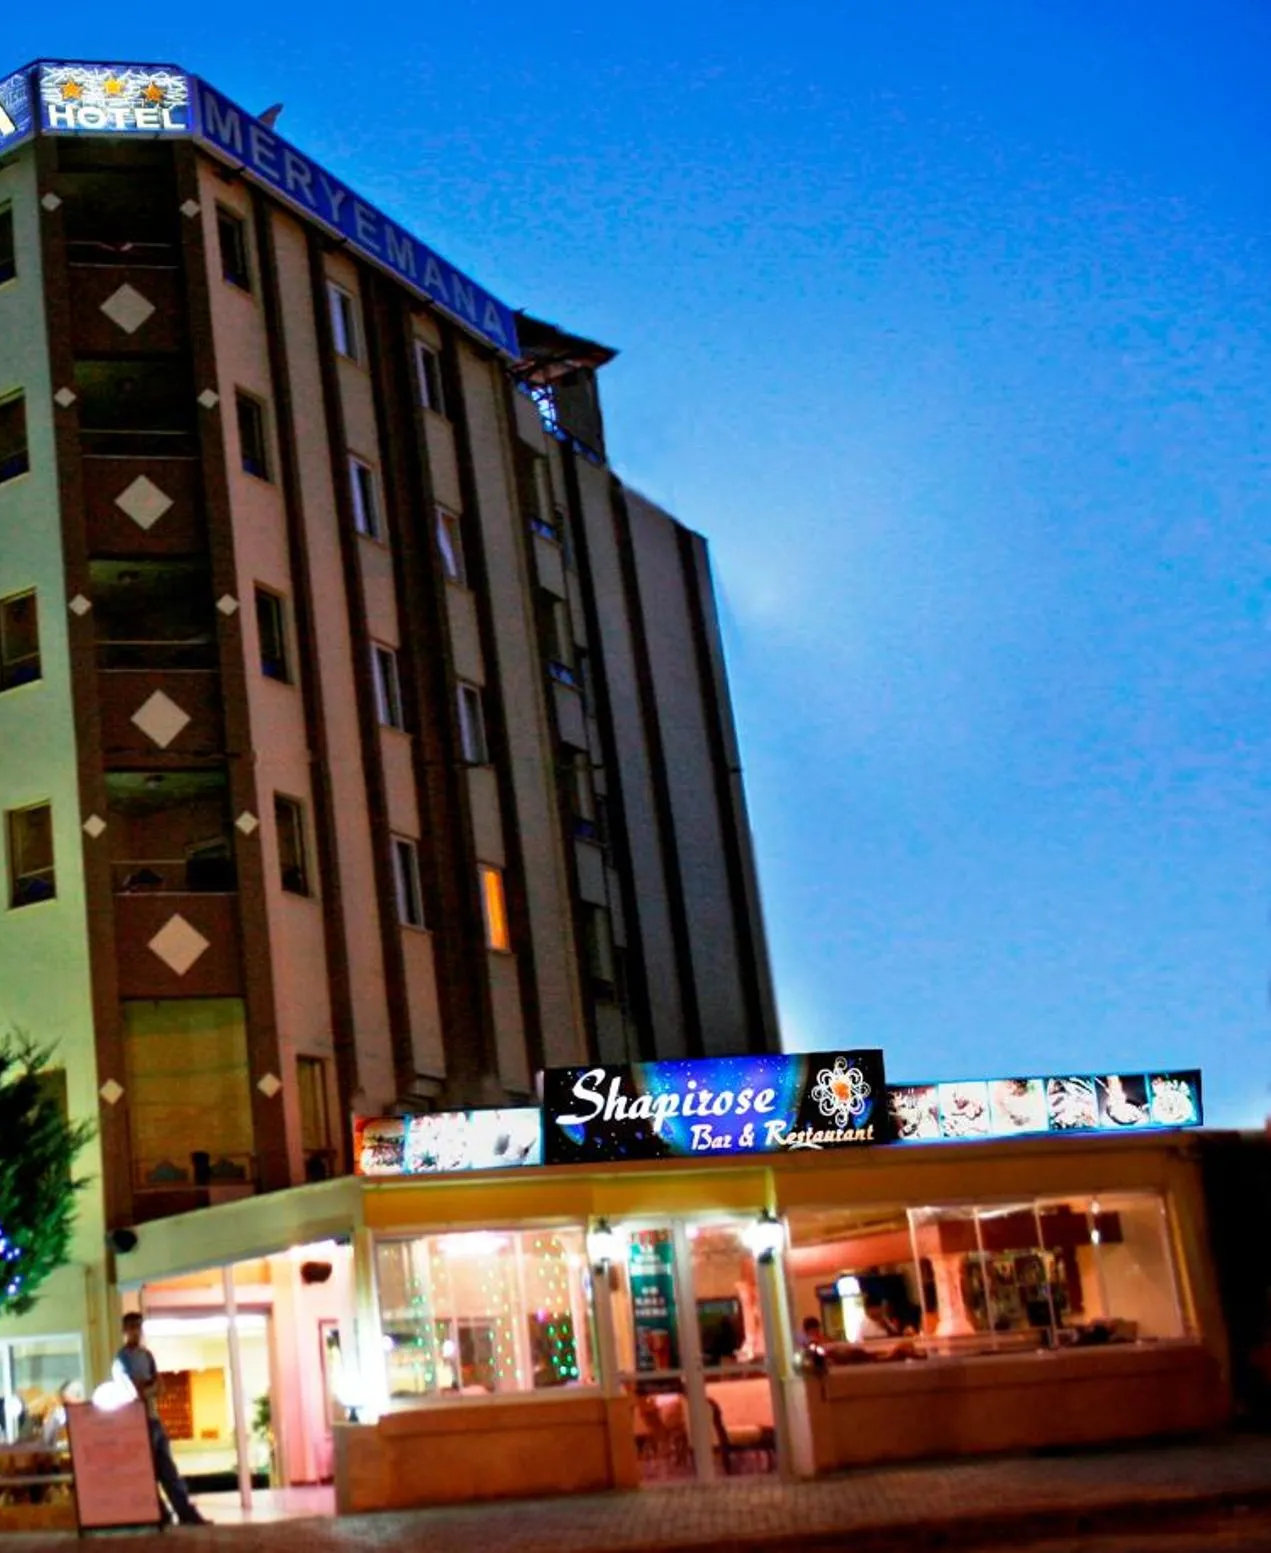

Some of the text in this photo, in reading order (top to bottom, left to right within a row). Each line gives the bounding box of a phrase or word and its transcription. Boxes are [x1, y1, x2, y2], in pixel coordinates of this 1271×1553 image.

[48, 104, 186, 129] HOTEL
[203, 91, 508, 343] MERYEMANA
[555, 1068, 777, 1133] Shapirose
[690, 1120, 875, 1150] Bar & Restaurant
